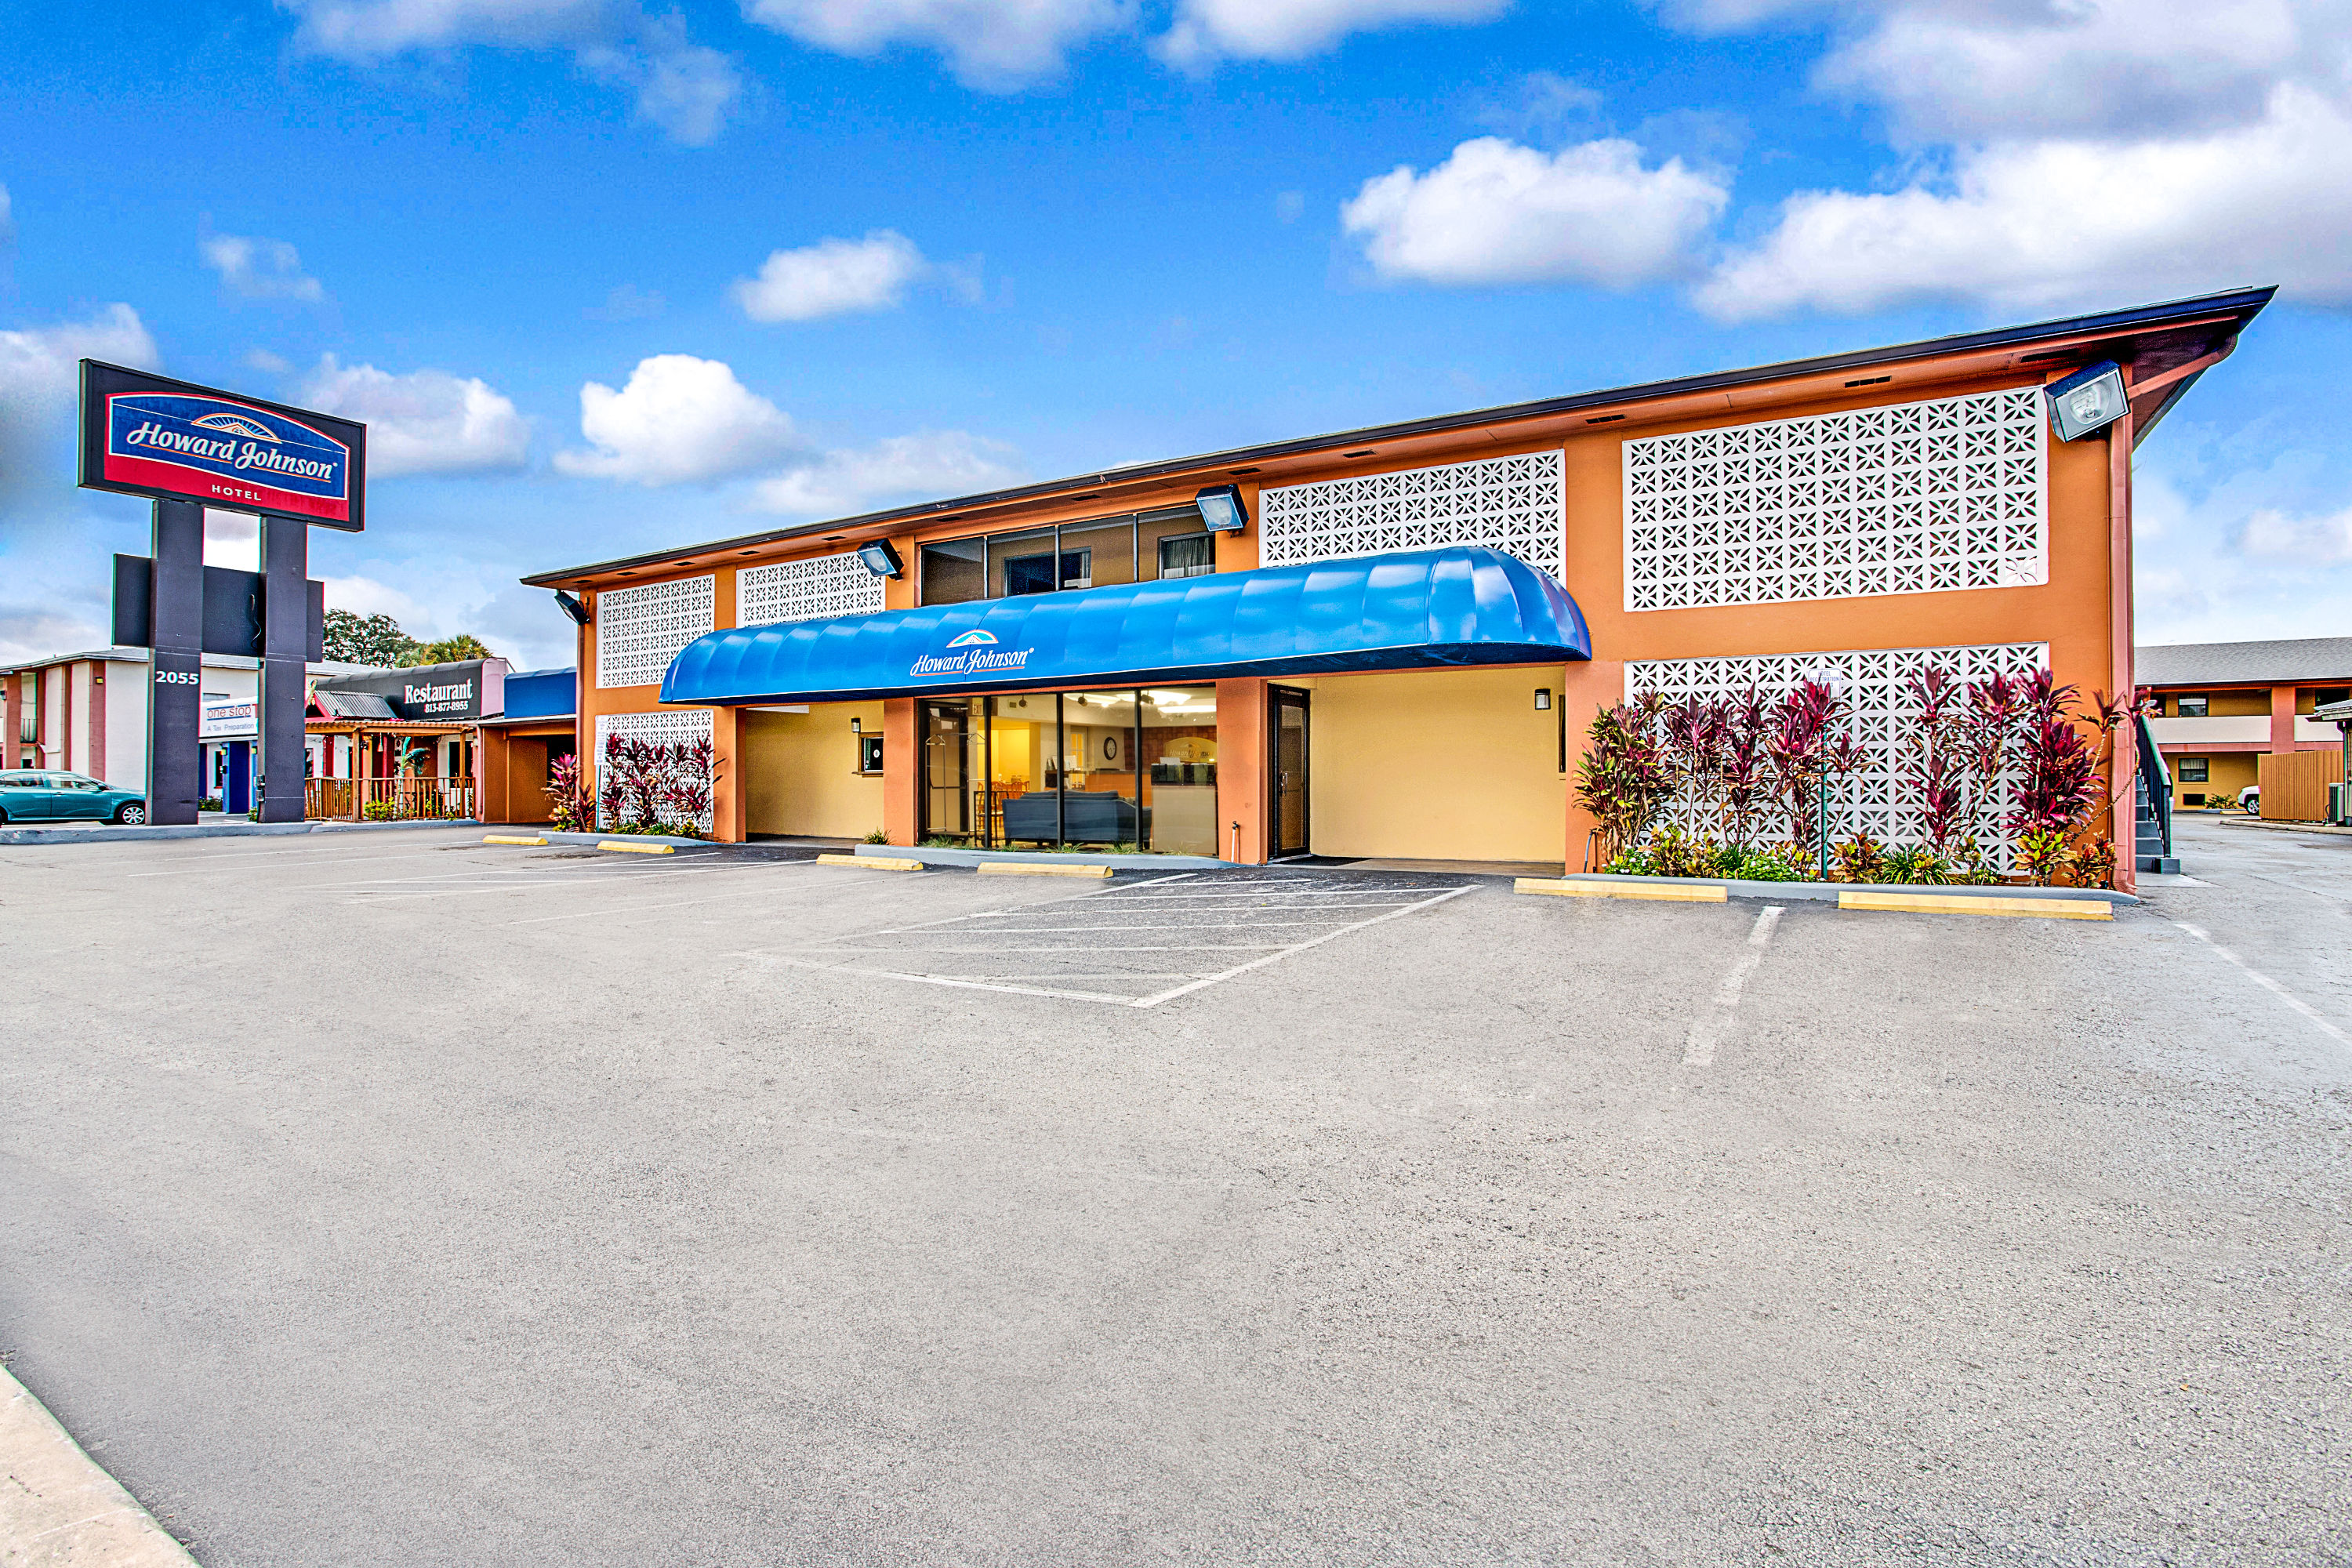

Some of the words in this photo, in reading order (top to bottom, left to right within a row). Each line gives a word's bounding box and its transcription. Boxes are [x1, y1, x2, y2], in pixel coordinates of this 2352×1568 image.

[126, 421, 235, 461] Howard
[234, 441, 333, 479] Johnson
[212, 484, 262, 501] HOTEL
[910, 651, 968, 676] Howard
[964, 649, 1029, 675] Johnson
[155, 670, 199, 685] 2055
[405, 678, 473, 704] Restaurant
[207, 708, 226, 719] one
[229, 706, 252, 717] stop
[424, 701, 469, 713] 813-877-8955
[224, 723, 255, 731] Preparation
